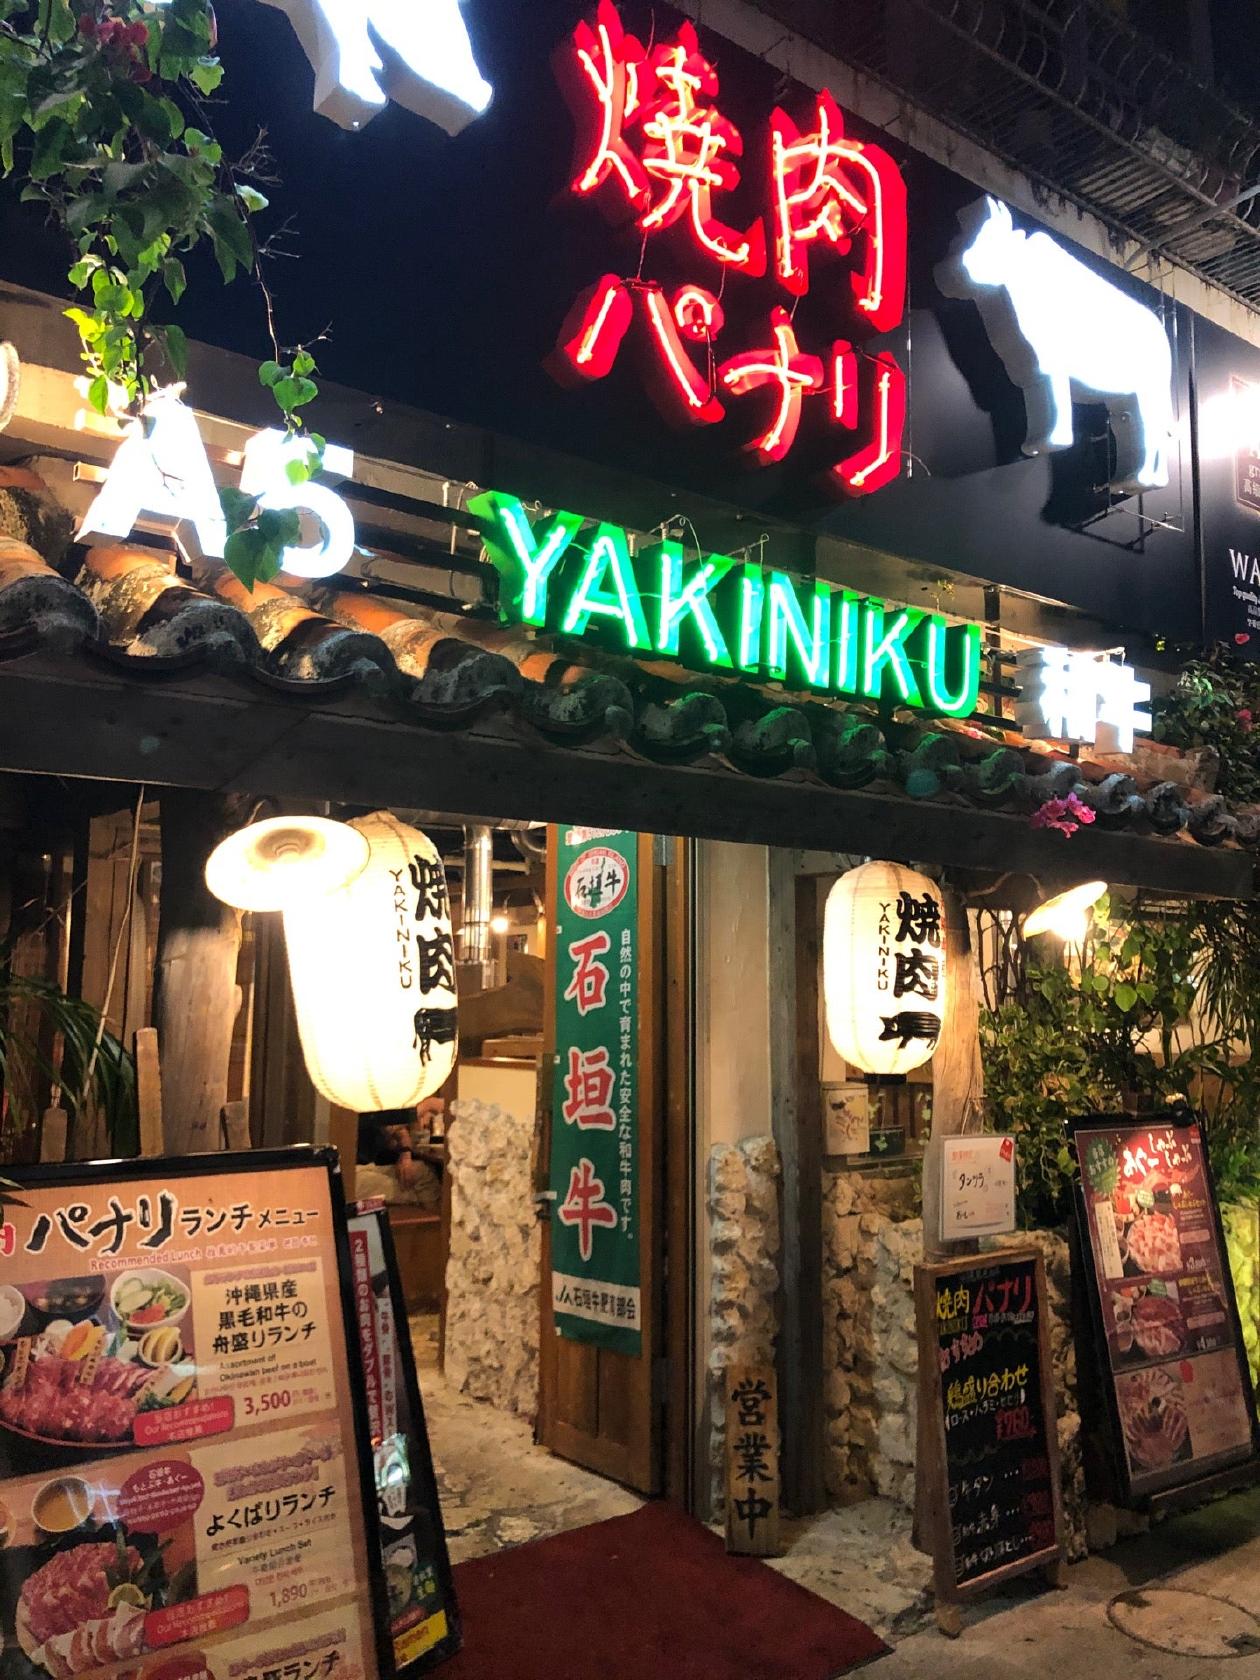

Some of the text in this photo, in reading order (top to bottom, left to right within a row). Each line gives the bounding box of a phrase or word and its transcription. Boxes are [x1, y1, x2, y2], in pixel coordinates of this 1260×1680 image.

[570, 2, 908, 334] 焼肉
[555, 273, 905, 497] パナリ
[74, 393, 355, 579] A5
[467, 491, 981, 719] YAKINIKU
[389, 868, 412, 989] YAKINIKU
[878, 902, 891, 990] YAKINIKU
[894, 891, 941, 1000] 焼肉
[559, 931, 618, 1262] 石垣牛
[619, 928, 634, 1240] 自然の中で育まれた安全な和牛肉です。
[25, 1191, 175, 1254] パナリ
[180, 1204, 319, 1236] ランチメニュー
[90, 1252, 168, 1271] Recommended
[170, 1247, 202, 1262] Lunch
[212, 1322, 316, 1355] 舟盛りランチ
[219, 1301, 308, 1331] 黒毛和牛の
[936, 1284, 970, 1320] 焼肉
[244, 1390, 291, 1416] 3,500
[731, 1376, 774, 1541] 営業中
[206, 1485, 336, 1537] よくばりランチ
[269, 1583, 308, 1608] 1,890
